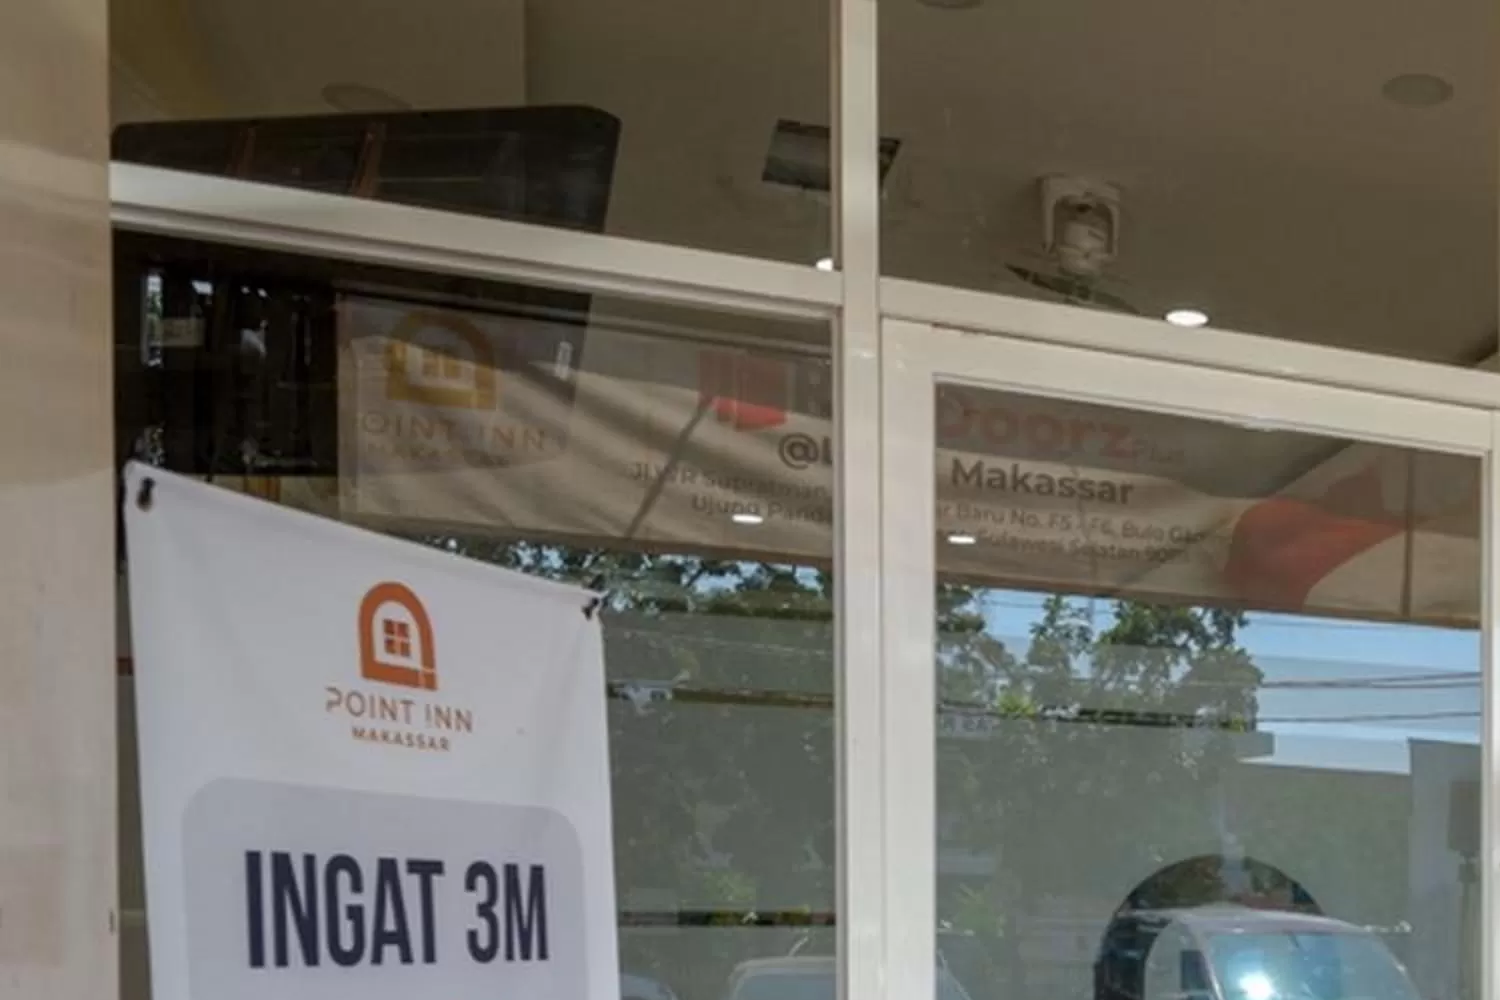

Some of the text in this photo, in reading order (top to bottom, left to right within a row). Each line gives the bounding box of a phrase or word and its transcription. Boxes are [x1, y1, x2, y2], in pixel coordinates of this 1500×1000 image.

[952, 457, 1134, 505] Makassar
[324, 686, 416, 725] POINT
[351, 726, 450, 751] MAKASSAR
[244, 849, 550, 969] INGAT 3M
